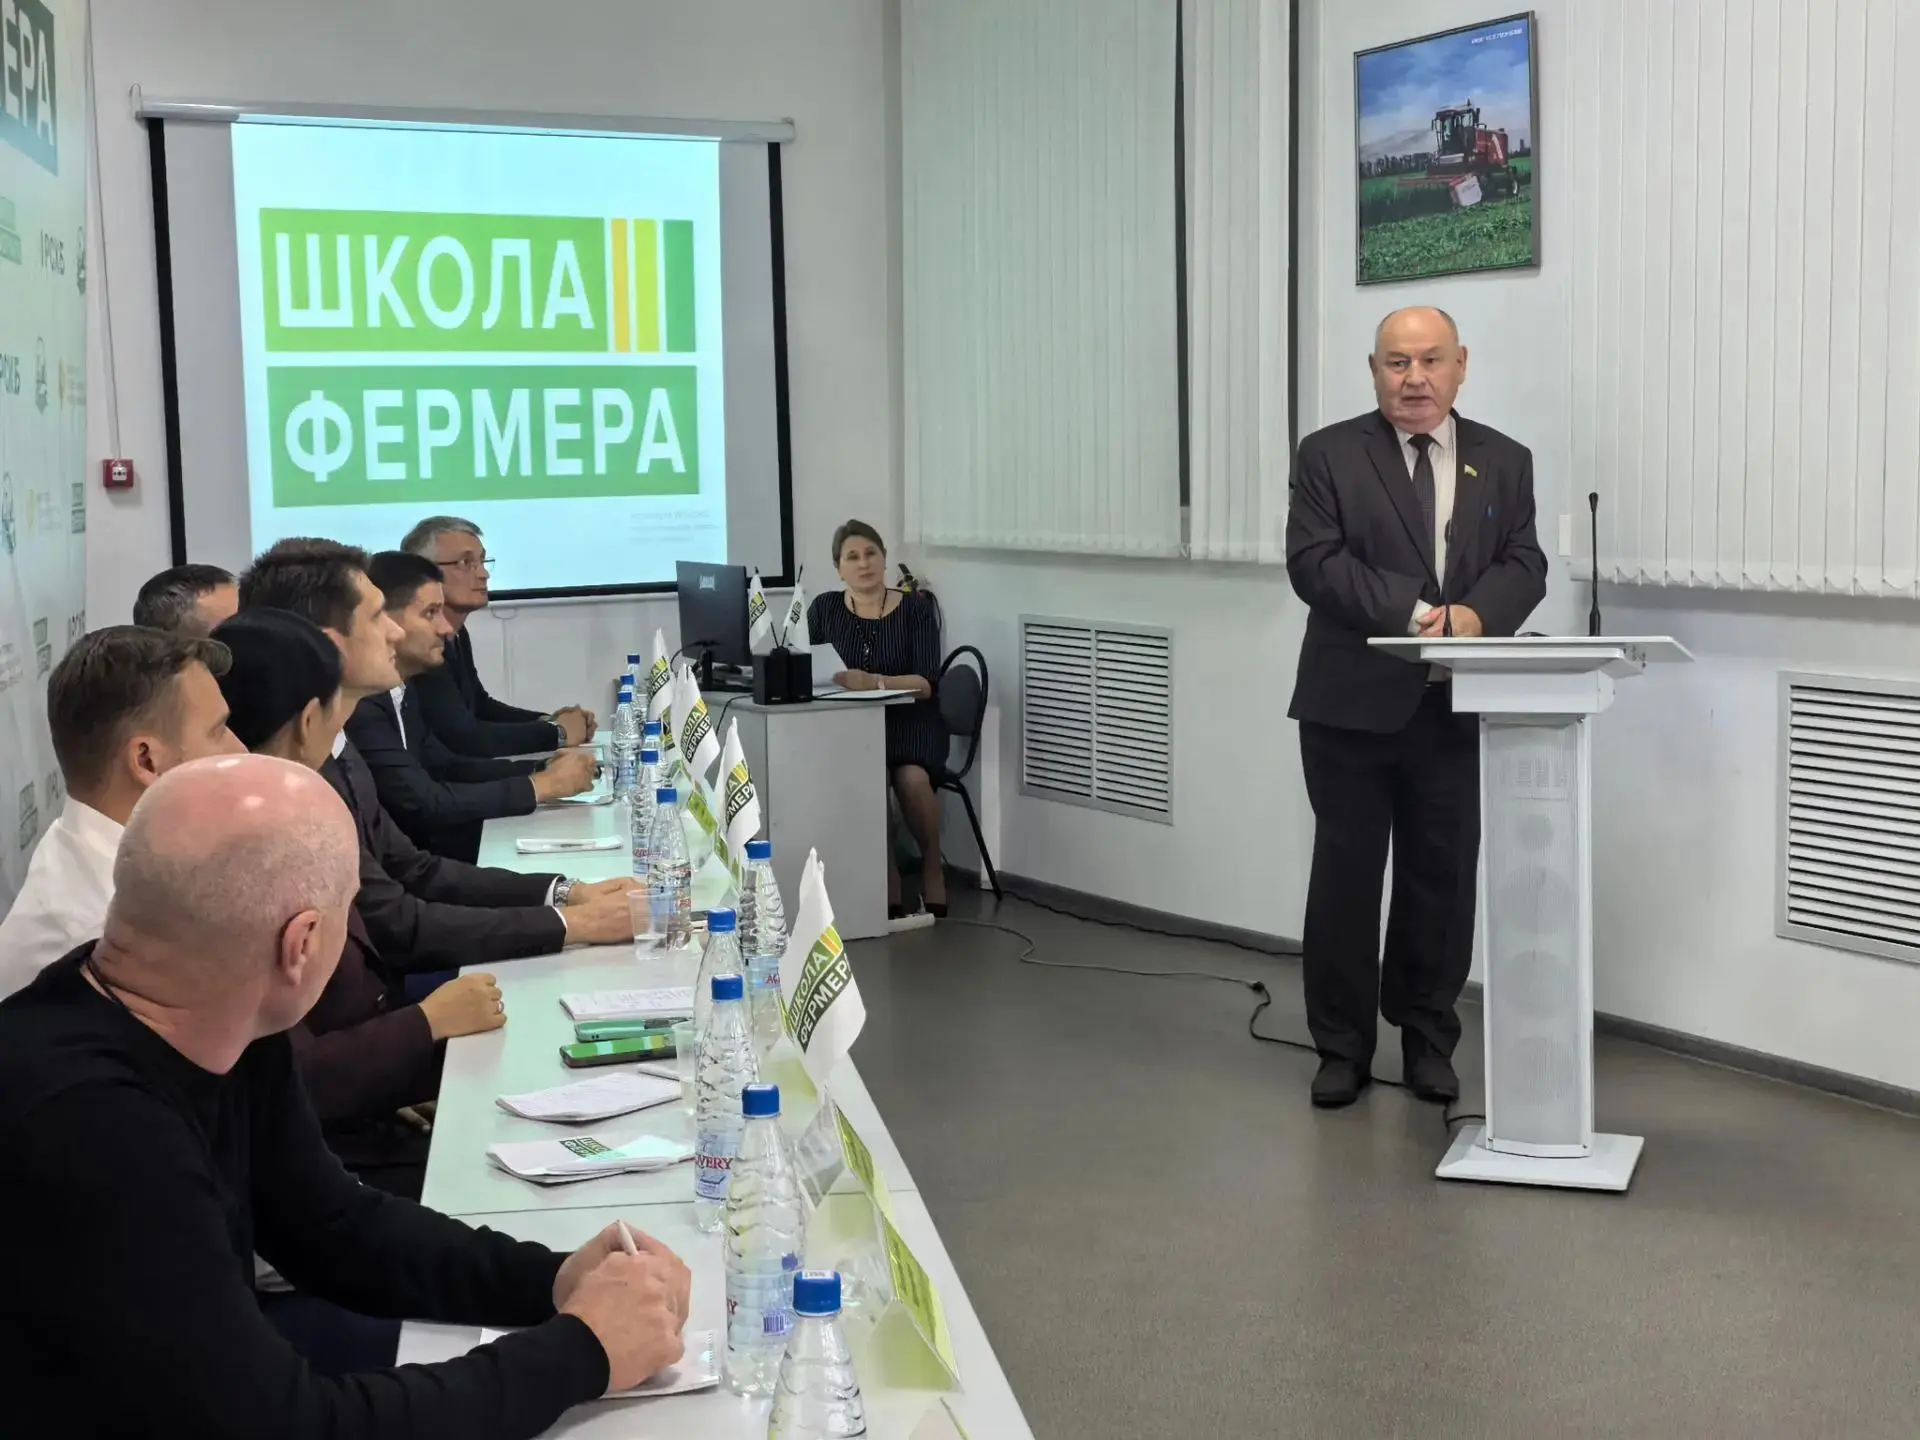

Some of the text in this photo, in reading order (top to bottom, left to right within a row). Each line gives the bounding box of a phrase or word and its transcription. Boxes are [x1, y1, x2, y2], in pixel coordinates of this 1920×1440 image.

[275, 232, 595, 330] ШКОЛА
[284, 387, 687, 482] ФЕРМЕРА
[790, 951, 829, 1026] ШКОЛА
[801, 955, 851, 1044] ФЕРМЕР
